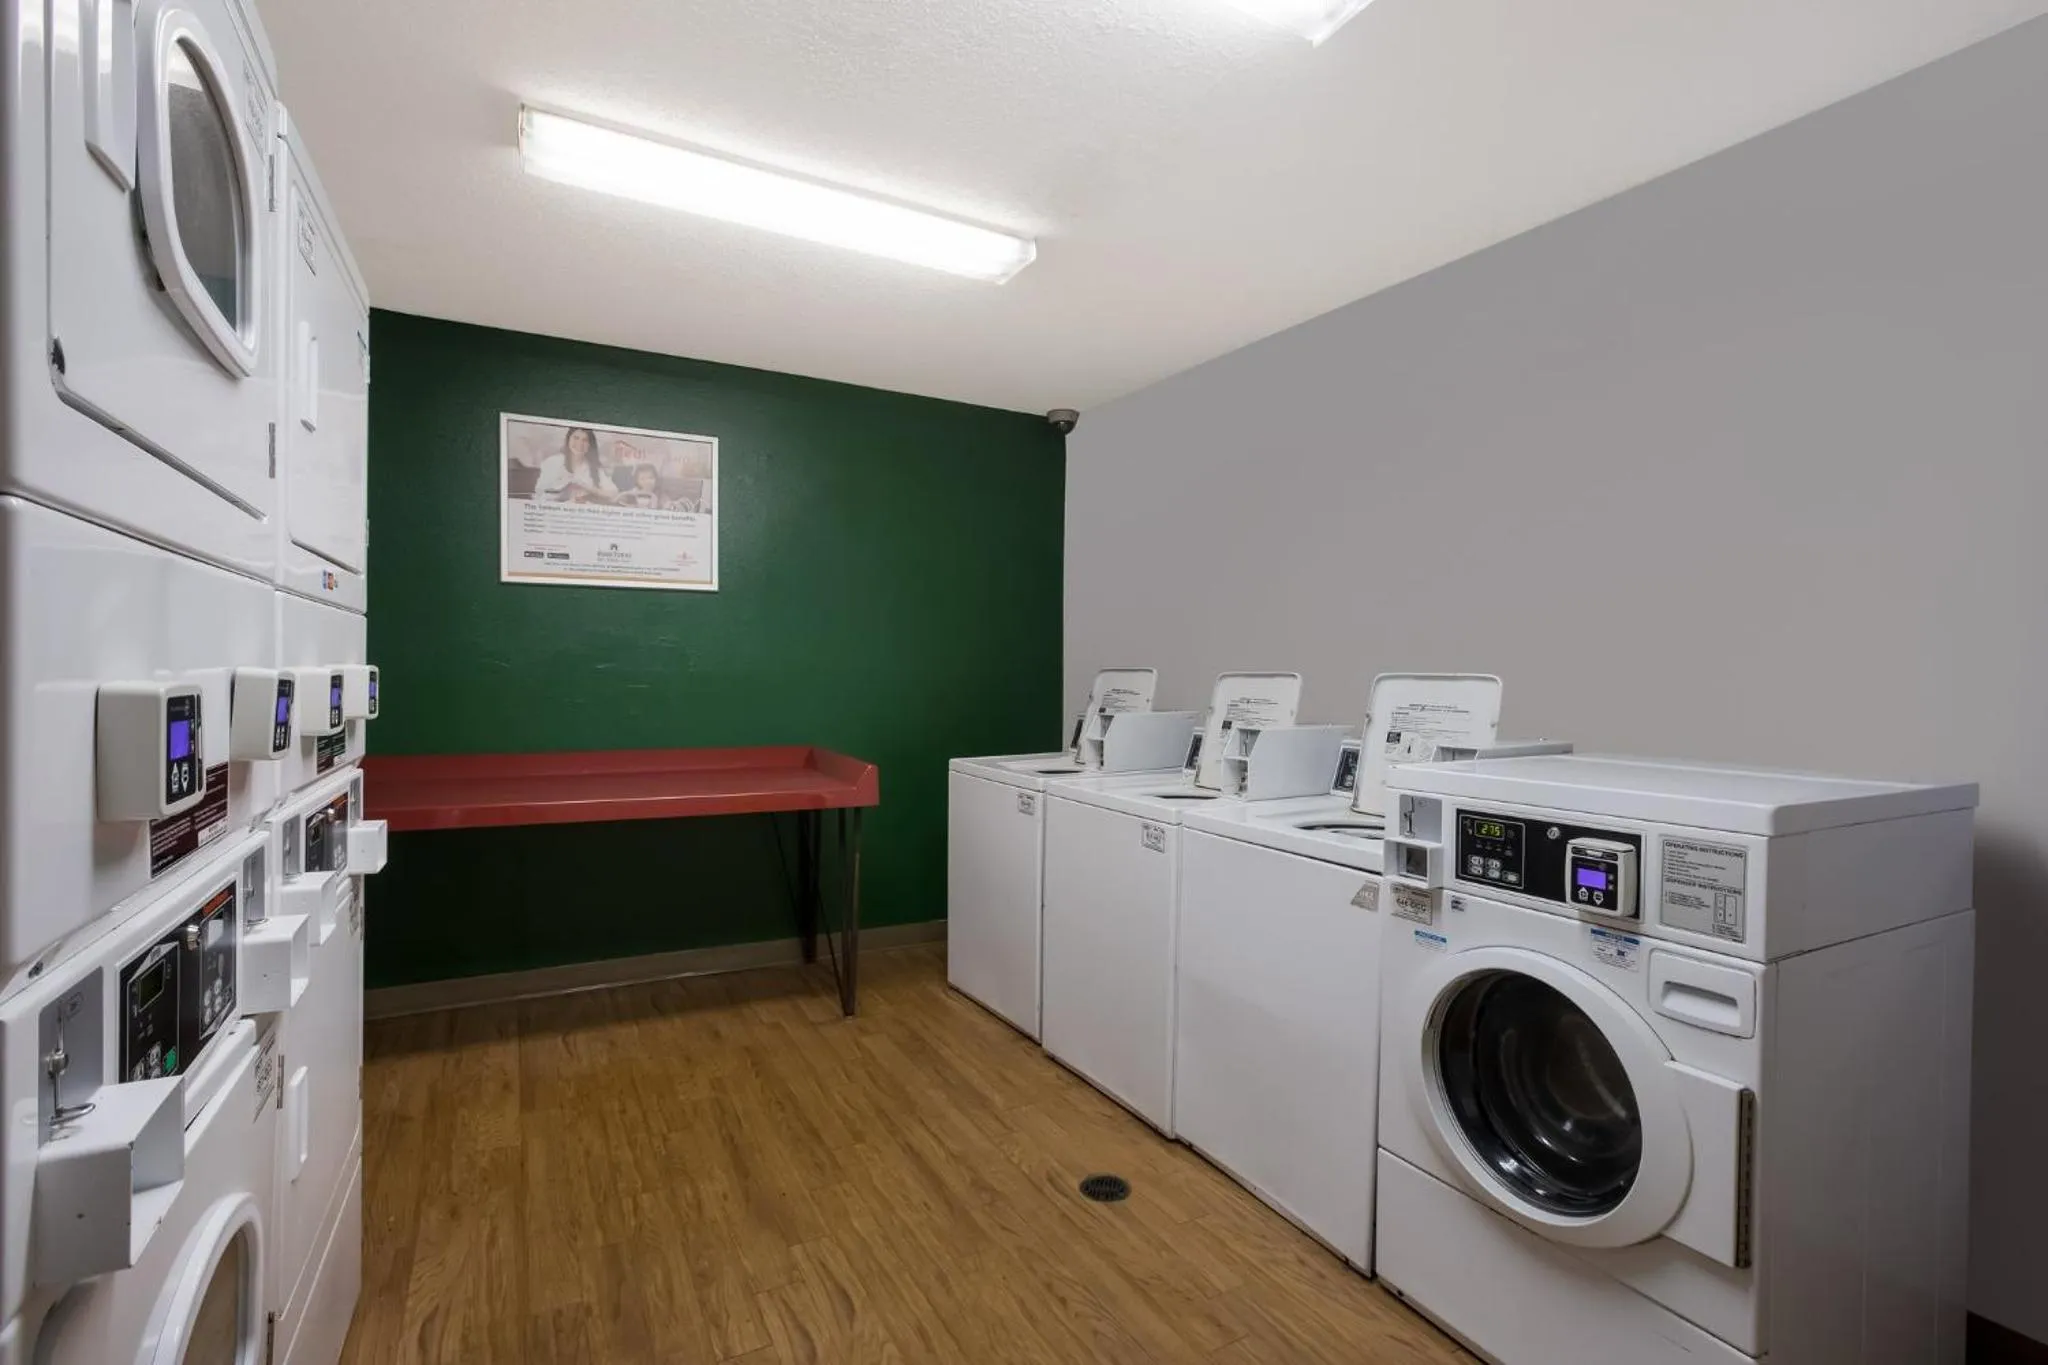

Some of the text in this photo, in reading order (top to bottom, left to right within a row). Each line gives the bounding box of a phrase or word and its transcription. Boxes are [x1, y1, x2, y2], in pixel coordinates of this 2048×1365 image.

[1665, 841, 1744, 858] OPERATING INSTRUCTIONS
[1698, 883, 1742, 895] INSTRUCTIONS
